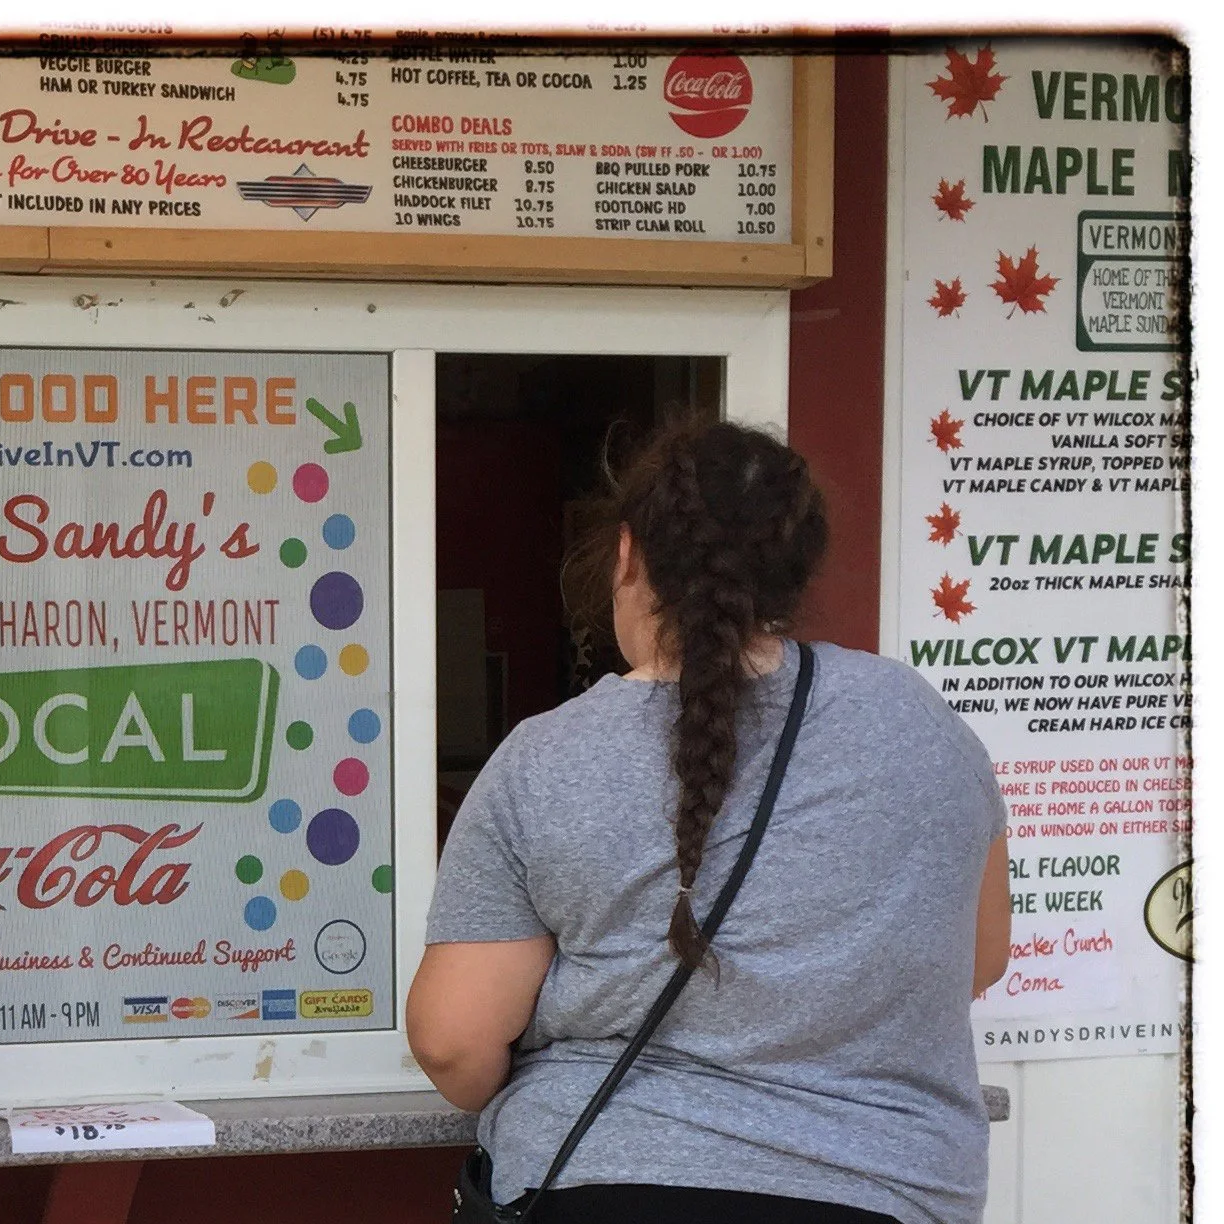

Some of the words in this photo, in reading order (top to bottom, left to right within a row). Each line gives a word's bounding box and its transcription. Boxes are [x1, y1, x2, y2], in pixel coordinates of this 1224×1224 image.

[392, 67, 420, 83] HOT
[427, 68, 480, 87] COFFEE,
[486, 71, 510, 87] TEA
[517, 73, 536, 87] OR
[542, 73, 592, 89] COCOA
[614, 75, 647, 90] 1.25
[40, 77, 72, 92] HAM
[78, 79, 98, 94] OR
[103, 80, 155, 97] TURKEY
[161, 82, 235, 101] SANDWICH
[0, 108, 97, 147] Drive
[128, 114, 171, 151] In
[178, 116, 370, 158] Restaurant
[392, 115, 454, 134] COMBO
[461, 116, 512, 135] DEALS
[393, 156, 487, 171] CHEESEBURGER
[525, 160, 554, 174] 8.50
[596, 162, 620, 176] BBQ
[626, 162, 671, 176] PULLED
[676, 163, 711, 177] PORK
[738, 163, 776, 177] 10.75
[982, 145, 1135, 196] MAPLE
[8, 154, 49, 187] for
[52, 155, 118, 184] Over
[122, 164, 150, 186] 80
[154, 159, 226, 194] Years
[393, 175, 497, 192] CHICKENBURGER
[525, 180, 555, 193] 8.75
[597, 182, 651, 195] CHICKEN
[656, 182, 696, 195] SALAD
[738, 183, 776, 196] 10.00
[7, 195, 83, 212] INCLUDED
[90, 198, 105, 213] IN
[112, 198, 143, 215] ANY
[149, 200, 201, 217] PRICES
[394, 194, 455, 208] HADDOCK
[461, 197, 492, 210] FILET
[515, 198, 554, 212] 10.75
[595, 200, 663, 213] FOOTLONG
[668, 202, 686, 214] HD
[746, 203, 775, 215] 7.00
[395, 212, 412, 225] 10
[417, 213, 461, 226] WINGS
[517, 216, 554, 228] 10.75
[595, 219, 630, 231] STRIP
[636, 220, 670, 232] CLAM
[676, 220, 706, 233] ROLL
[738, 221, 775, 234] 10.50
[958, 369, 1010, 401] VT
[1021, 369, 1151, 401] MAPLE
[144, 375, 296, 425] HERE
[974, 413, 1035, 427] CHOICE
[1039, 413, 1061, 427] OF
[1067, 413, 1088, 426] VT
[1094, 412, 1154, 427] WILCOX
[1052, 435, 1119, 449] VANILLA
[1124, 434, 1166, 448] SOFT
[950, 457, 973, 471] VT
[976, 457, 1033, 471] MAPLE
[1038, 457, 1096, 473] SYRUP,
[1102, 456, 1164, 470] TOPPED
[943, 479, 965, 493] VT
[969, 479, 1027, 493] MAPLE
[1030, 478, 1087, 492] CANDY
[1092, 478, 1103, 492] &
[1109, 478, 1131, 492] VT
[968, 534, 1020, 566] VT
[1028, 533, 1159, 565] MAPLE
[990, 577, 1029, 591] 20oz
[1035, 576, 1084, 590] THICK
[1089, 575, 1144, 589] MAPLE
[131, 600, 279, 646] VERMONT
[910, 637, 1041, 666] WILCOX
[1054, 636, 1098, 664] VT
[942, 678, 960, 692] IN
[964, 676, 1044, 691] ADDITION
[1050, 676, 1070, 689] TO
[1074, 675, 1109, 688] OUR
[1114, 673, 1175, 687] WILCOX
[1005, 698, 1029, 712] WE
[1034, 697, 1074, 711] NOW
[1077, 695, 1122, 710] HAVE
[1126, 695, 1167, 709] PURE
[1028, 718, 1086, 733] CREAM
[1090, 717, 1136, 731] HARD
[1141, 716, 1166, 729] ICE
[1039, 855, 1120, 879] FLAVOR
[1046, 891, 1103, 911] WEEK
[1064, 928, 1112, 956] Crunch
[78, 946, 94, 969] &
[103, 939, 206, 970] Continued
[214, 938, 295, 972] Support
[1007, 972, 1064, 996] Coma
[304, 996, 327, 1004] GIFT
[332, 993, 368, 1003] CARDS
[0, 1005, 15, 1030] 11
[21, 1003, 45, 1029] AM
[61, 1002, 72, 1027] 9
[77, 1001, 99, 1027] PM
[132, 1004, 161, 1015] VISA
[314, 1005, 359, 1013] Available
